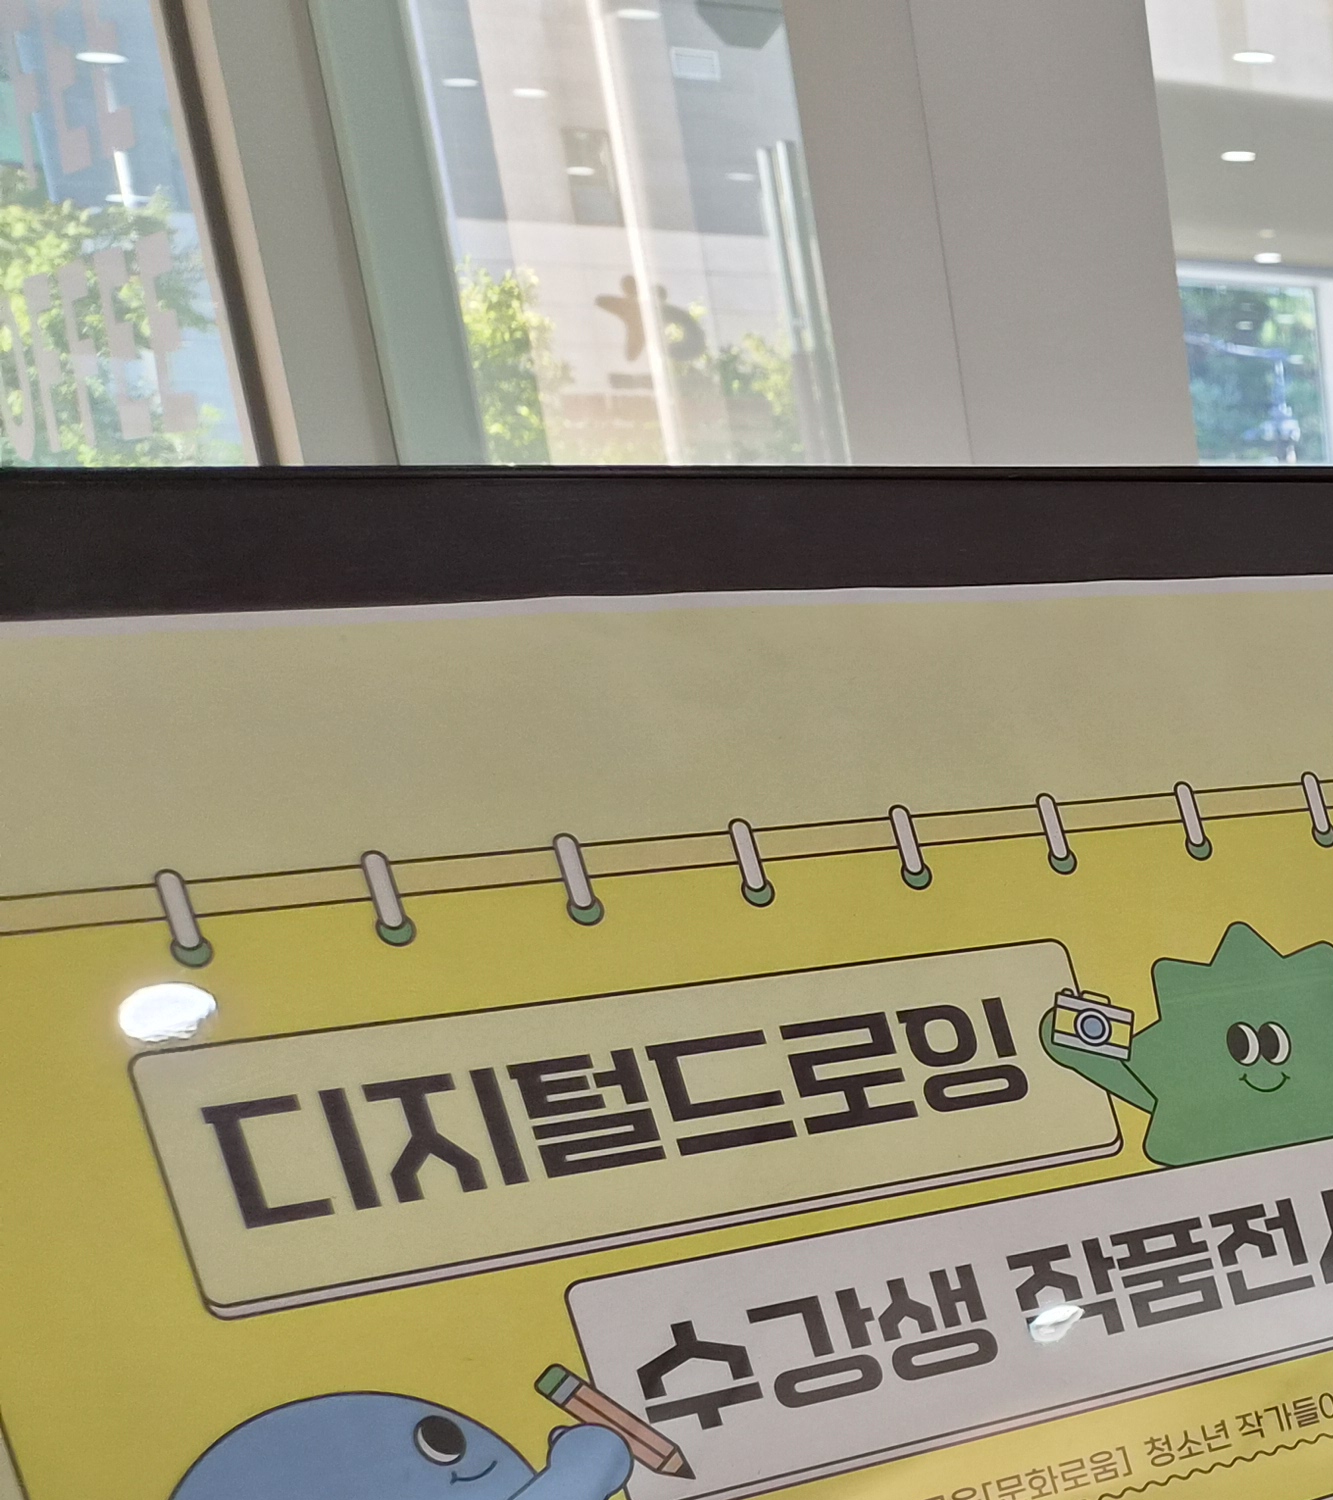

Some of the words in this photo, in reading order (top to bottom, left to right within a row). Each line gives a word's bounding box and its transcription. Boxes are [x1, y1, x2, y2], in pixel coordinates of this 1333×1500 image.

[201, 998, 1029, 1229] 디지털드로잉
[636, 1263, 999, 1431] 수강생
[1144, 1420, 1233, 1468] 청소년
